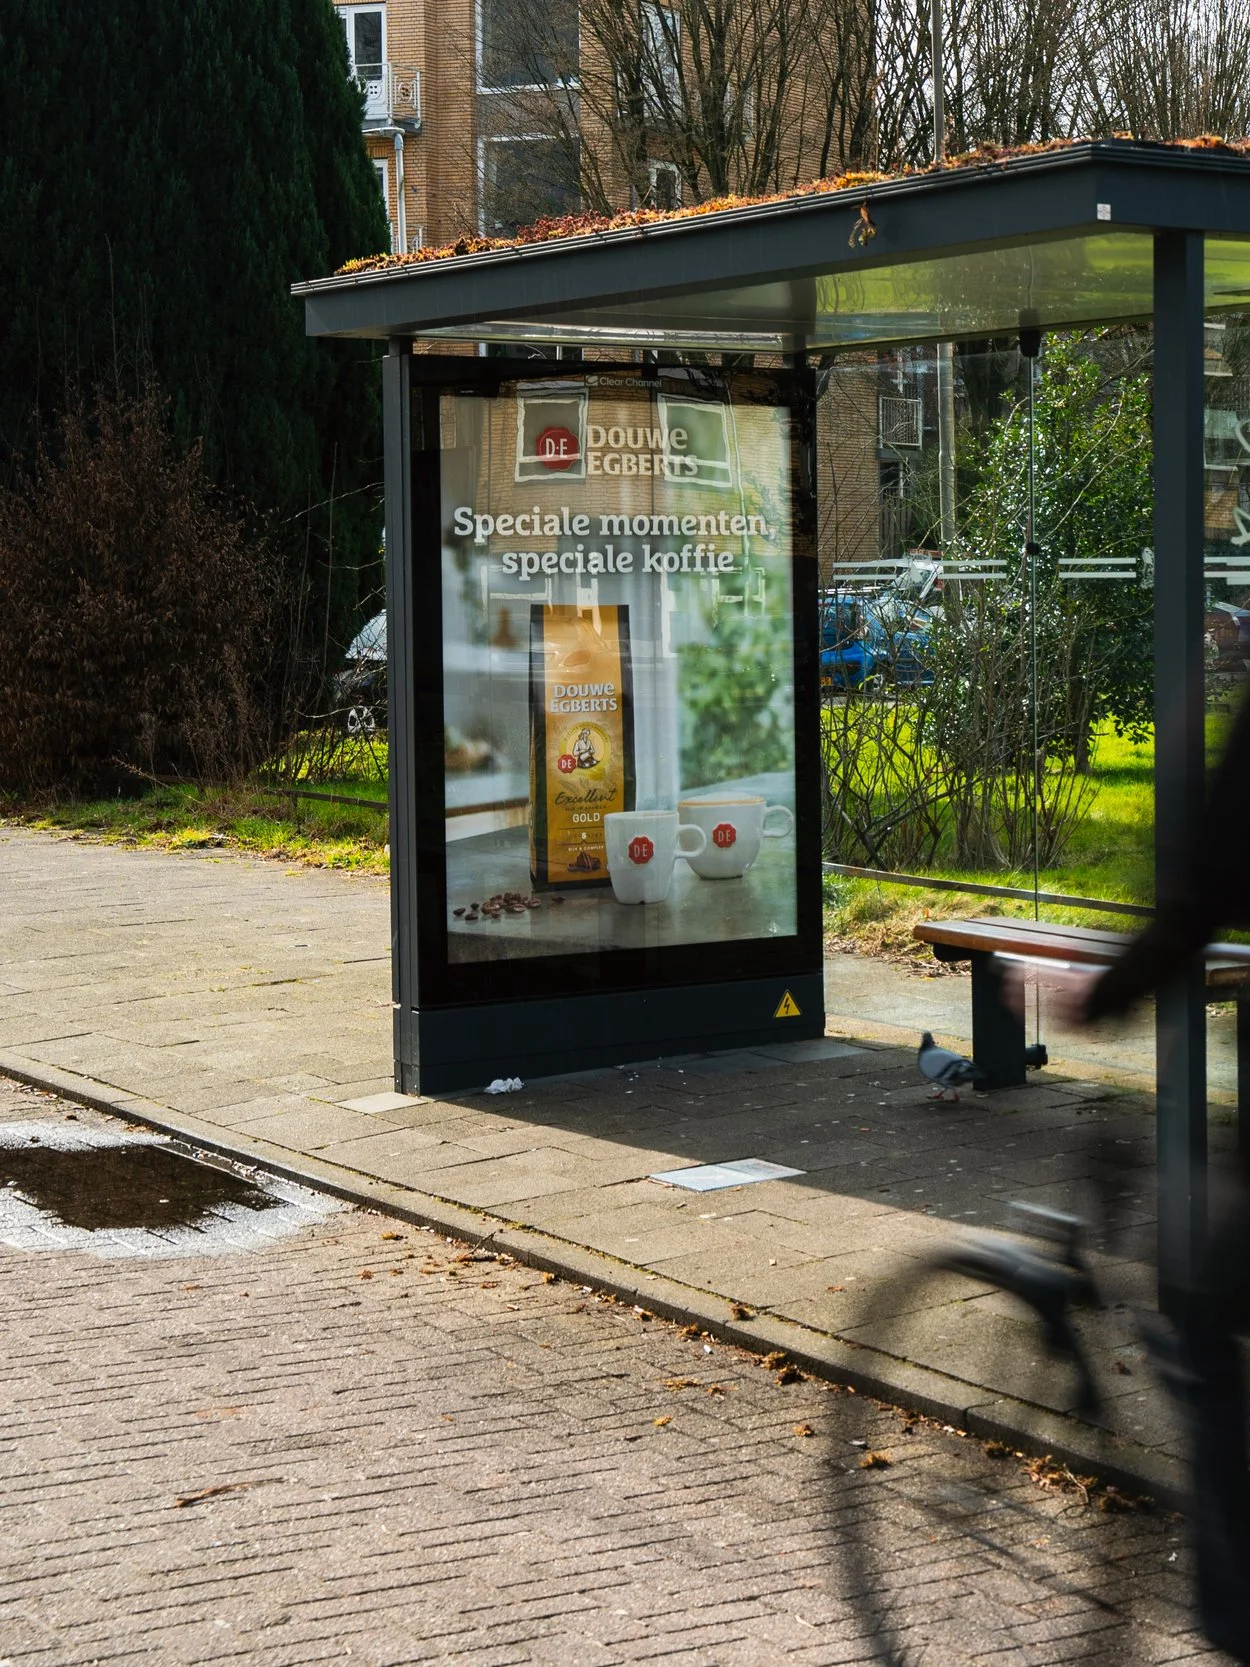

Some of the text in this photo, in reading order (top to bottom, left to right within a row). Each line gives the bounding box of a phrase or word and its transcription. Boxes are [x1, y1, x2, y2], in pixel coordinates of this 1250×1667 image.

[599, 376, 663, 389] Clear Channel
[586, 451, 699, 477] EGBERTS
[453, 506, 591, 544] Speciale
[502, 542, 735, 581] speciale koffie
[549, 698, 618, 713] EGBERTS
[555, 787, 618, 805] Excellent
[572, 812, 601, 823] GOLD
